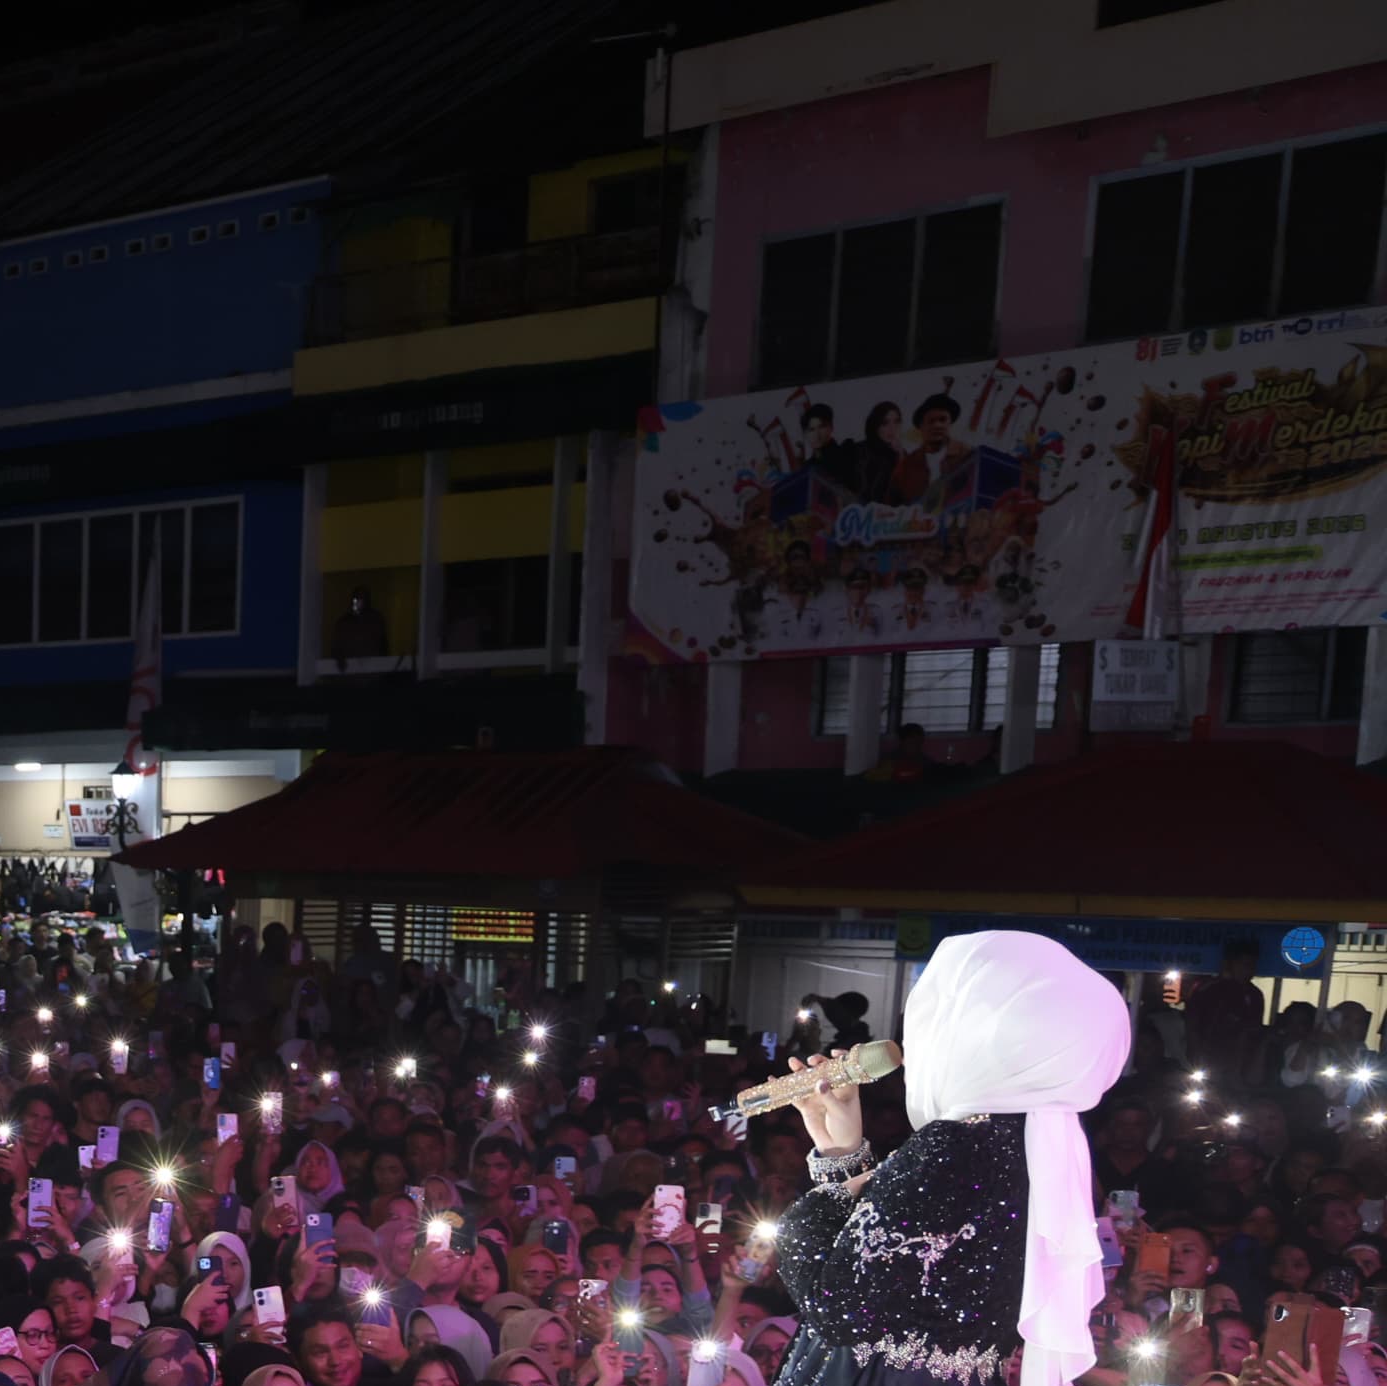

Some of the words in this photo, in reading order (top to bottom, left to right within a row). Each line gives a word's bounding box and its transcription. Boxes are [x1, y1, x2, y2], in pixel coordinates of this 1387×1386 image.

[1238, 324, 1276, 345] btn
[1196, 368, 1317, 431] Festival
[1197, 520, 1296, 544] AGUSTUS
